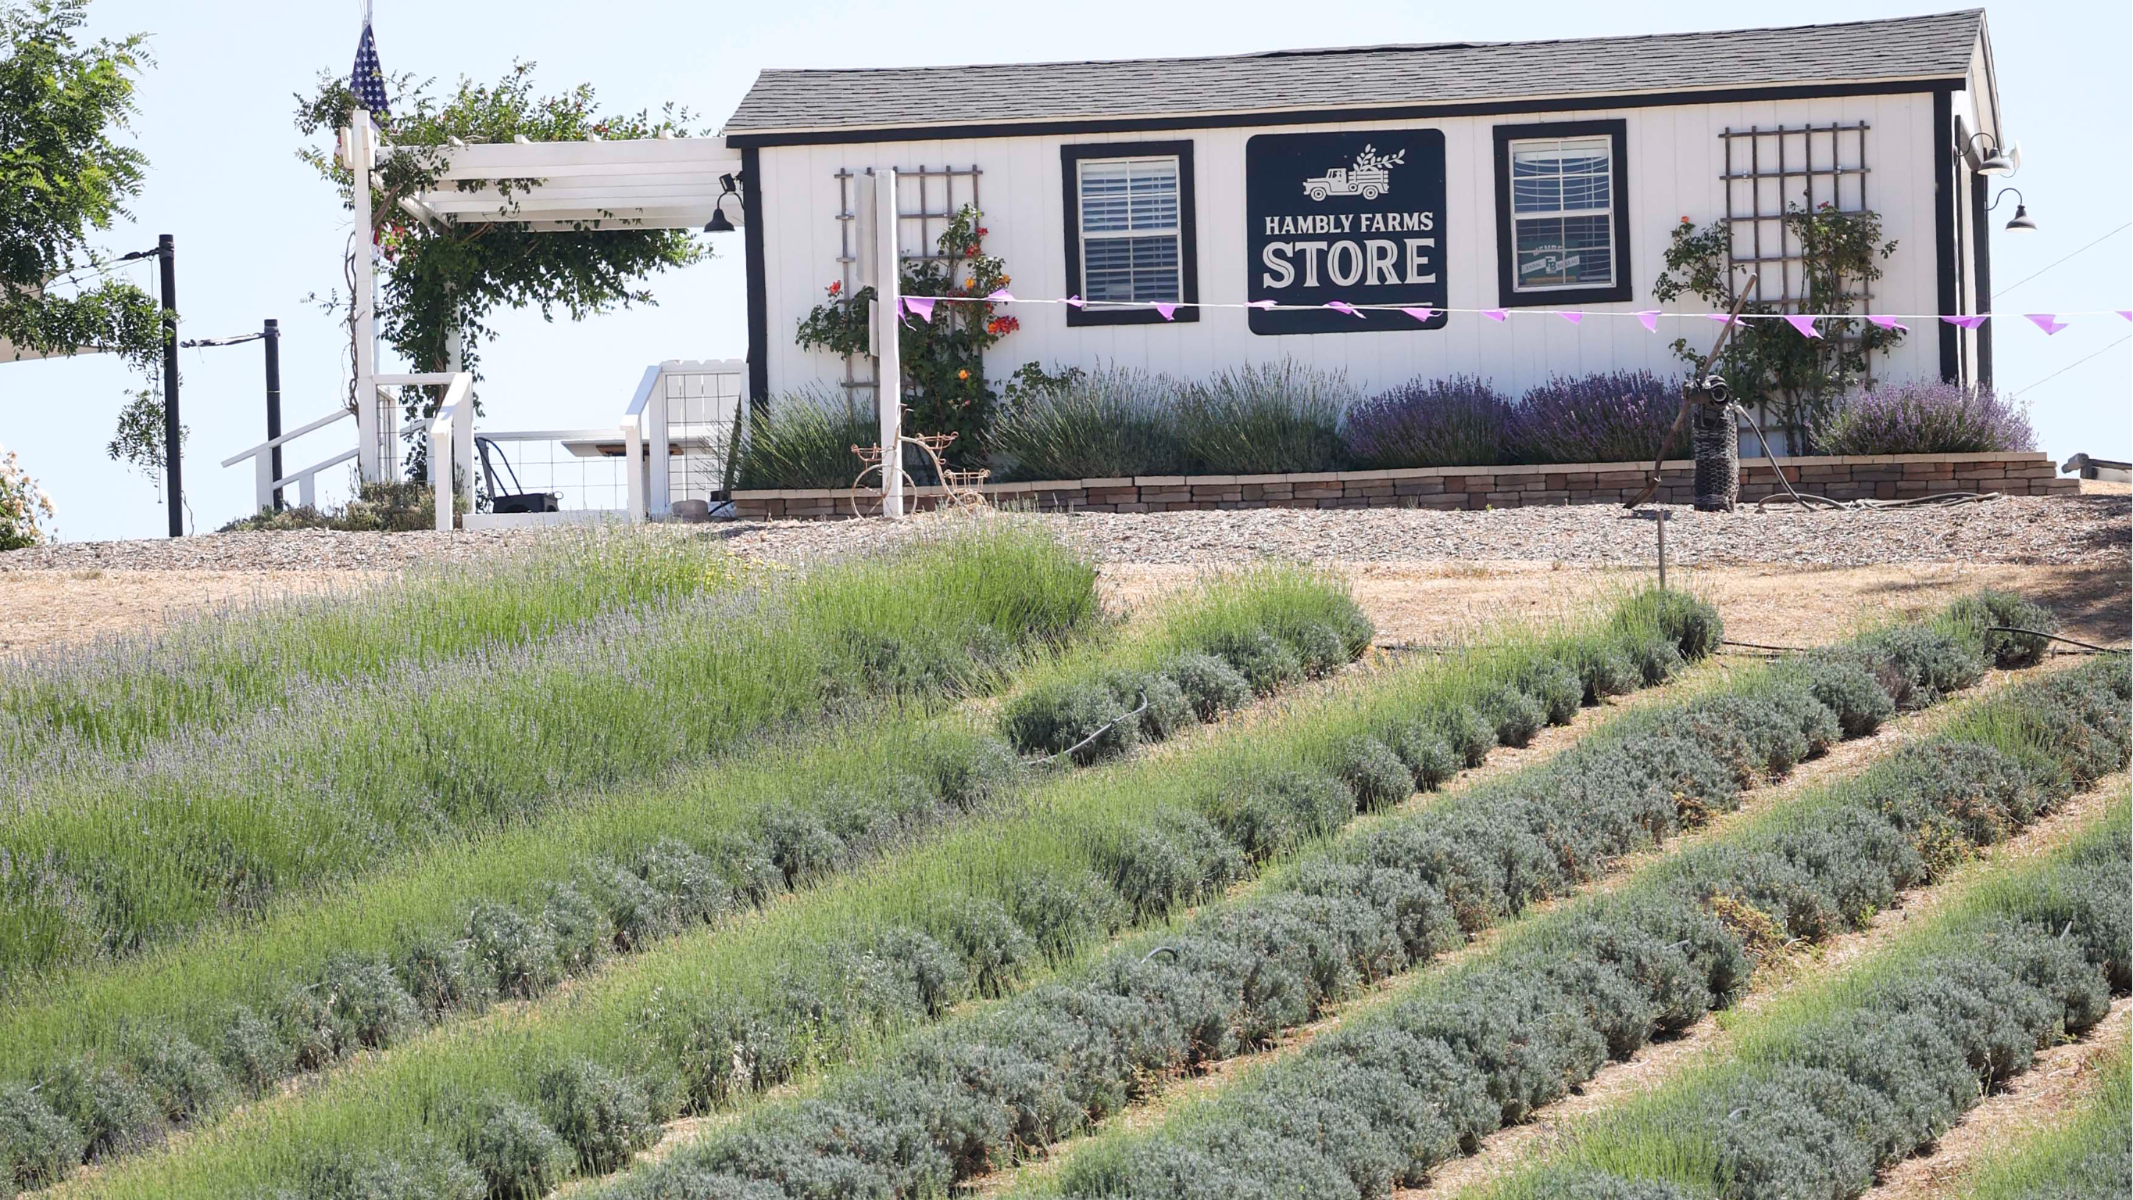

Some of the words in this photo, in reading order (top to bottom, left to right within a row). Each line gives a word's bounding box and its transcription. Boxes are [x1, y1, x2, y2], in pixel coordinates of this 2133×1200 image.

[1265, 214, 1354, 235] HAMBLY
[1360, 212, 1434, 232] FARMS
[1532, 245, 1567, 256] MEMBE
[1263, 238, 1436, 289] STORE
